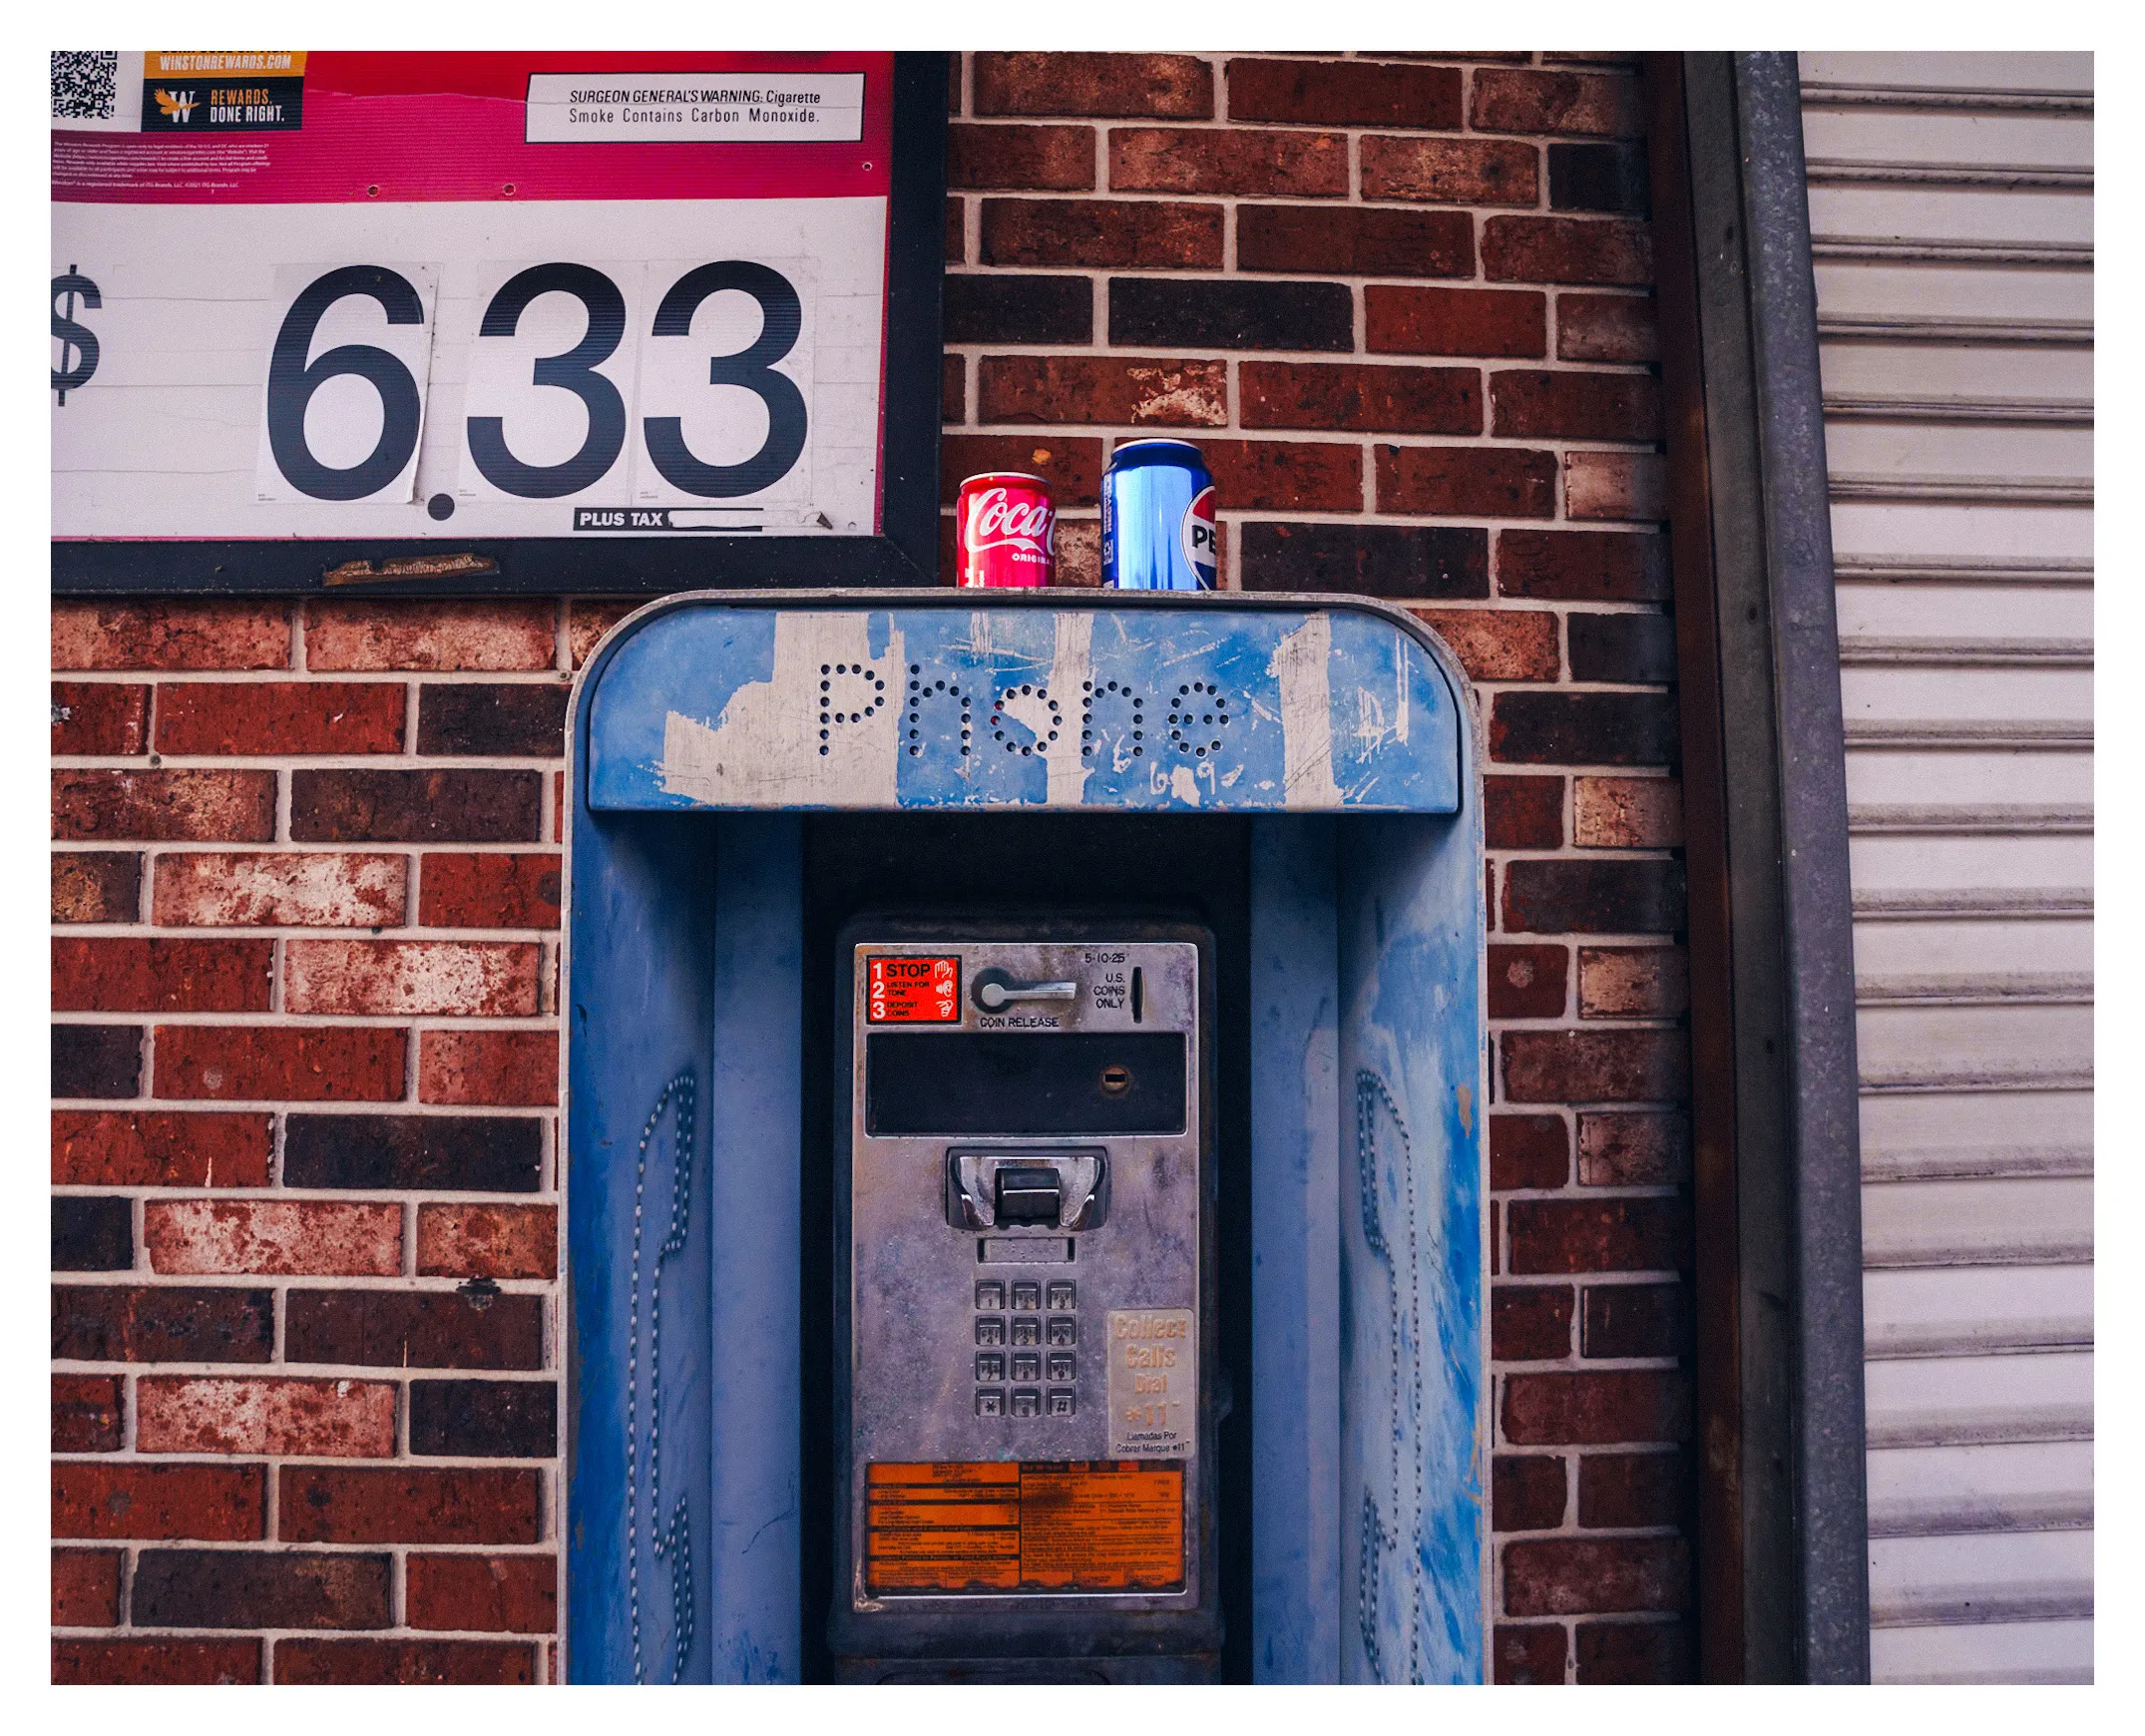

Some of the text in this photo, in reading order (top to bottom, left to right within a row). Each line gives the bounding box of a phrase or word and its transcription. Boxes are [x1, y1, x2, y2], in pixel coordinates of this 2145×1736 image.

[160, 55, 291, 71] WINSTONREWARDS.COM
[211, 89, 272, 106] REWARDS.
[570, 90, 821, 107] SURGEON GENERAL'S WARNING: Cigarette
[210, 105, 285, 123] DONE RIGHT.
[570, 108, 820, 123] Smoke Contains Carbon Monoxide.
[51, 263, 103, 407] $
[580, 512, 663, 527] PLUS TAX
[819, 662, 1230, 757] Phone
[873, 962, 930, 980] 1 STOP
[1105, 973, 1125, 983] U.S.
[872, 981, 885, 999] 2
[1093, 986, 1125, 996] COINS
[872, 1001, 885, 1019] 3
[1095, 999, 1124, 1010] ONLY
[980, 1017, 1060, 1028] COIN RELEASE
[1114, 1314, 1186, 1341] Collect
[1125, 1344, 1176, 1369] Calls
[1134, 1372, 1167, 1394] Dial
[1163, 1431, 1177, 1440] Por
